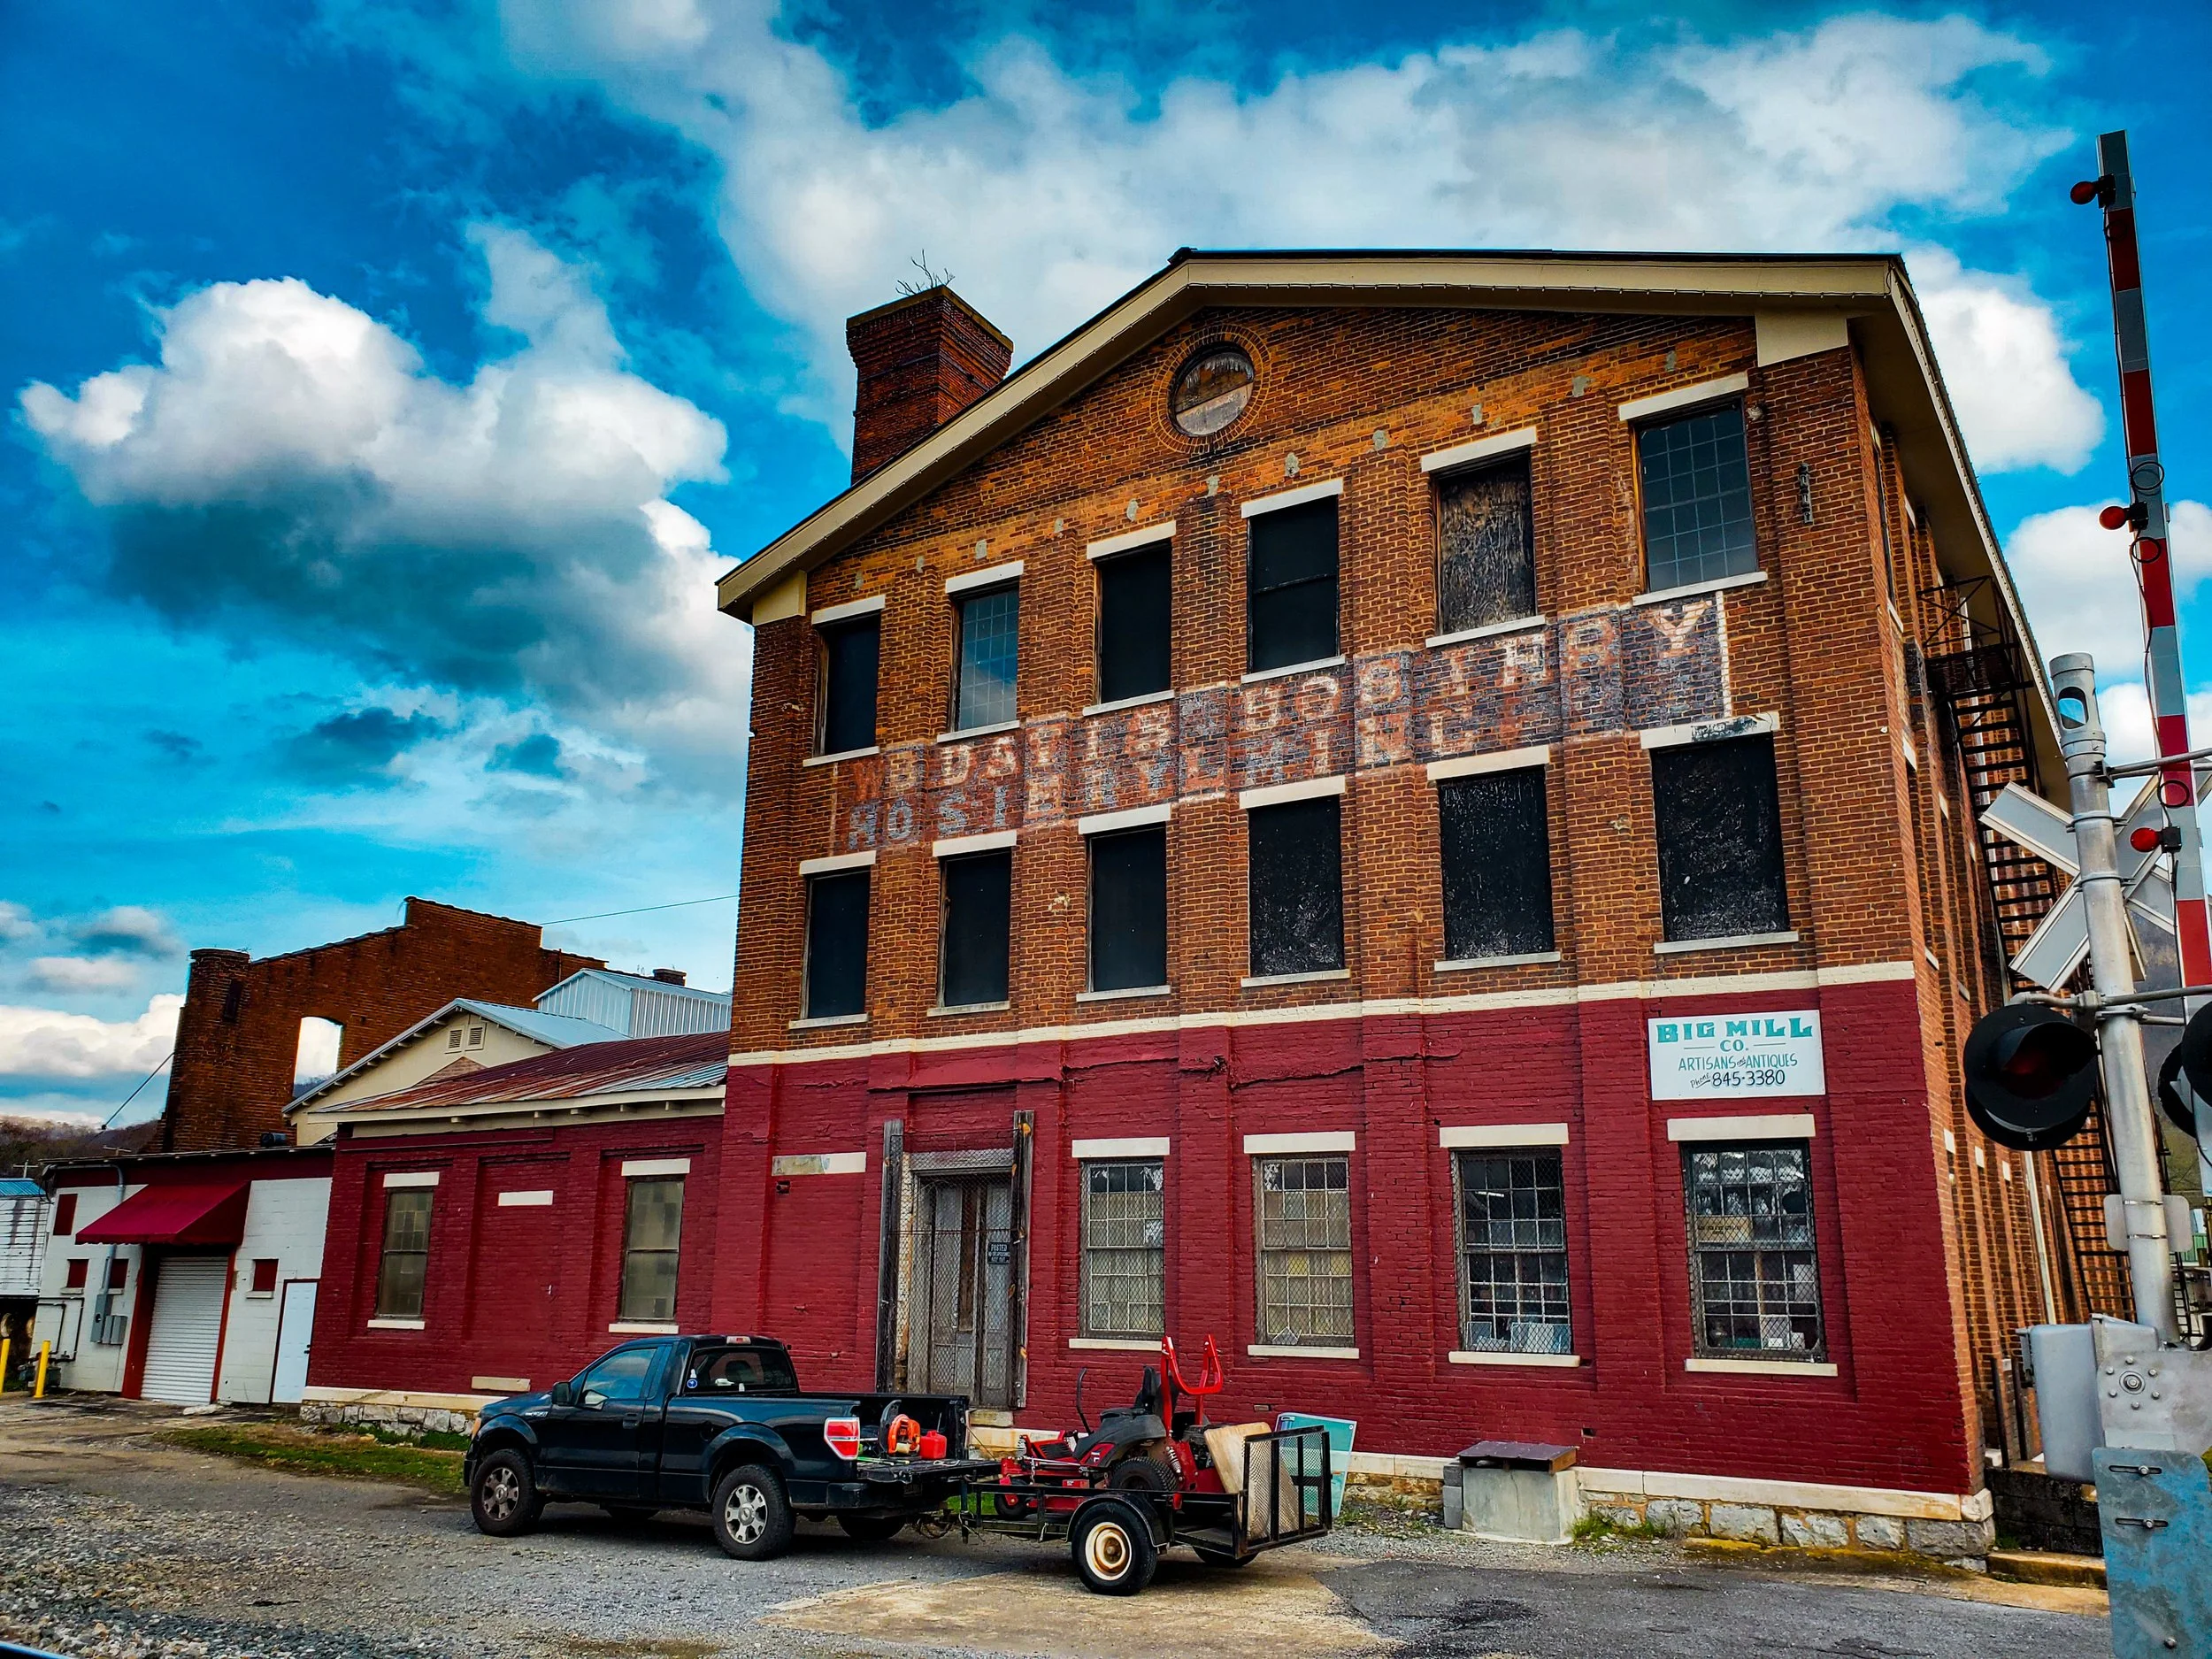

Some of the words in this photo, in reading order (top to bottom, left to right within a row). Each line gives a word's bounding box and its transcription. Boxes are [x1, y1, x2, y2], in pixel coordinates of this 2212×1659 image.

[1656, 1022, 1715, 1042] BIG
[1724, 1018, 1812, 1038] MILL
[1719, 1040, 1748, 1052] CO.
[1678, 1056, 1736, 1071] ARTISANS
[1746, 1053, 1798, 1069] ANTIQUES
